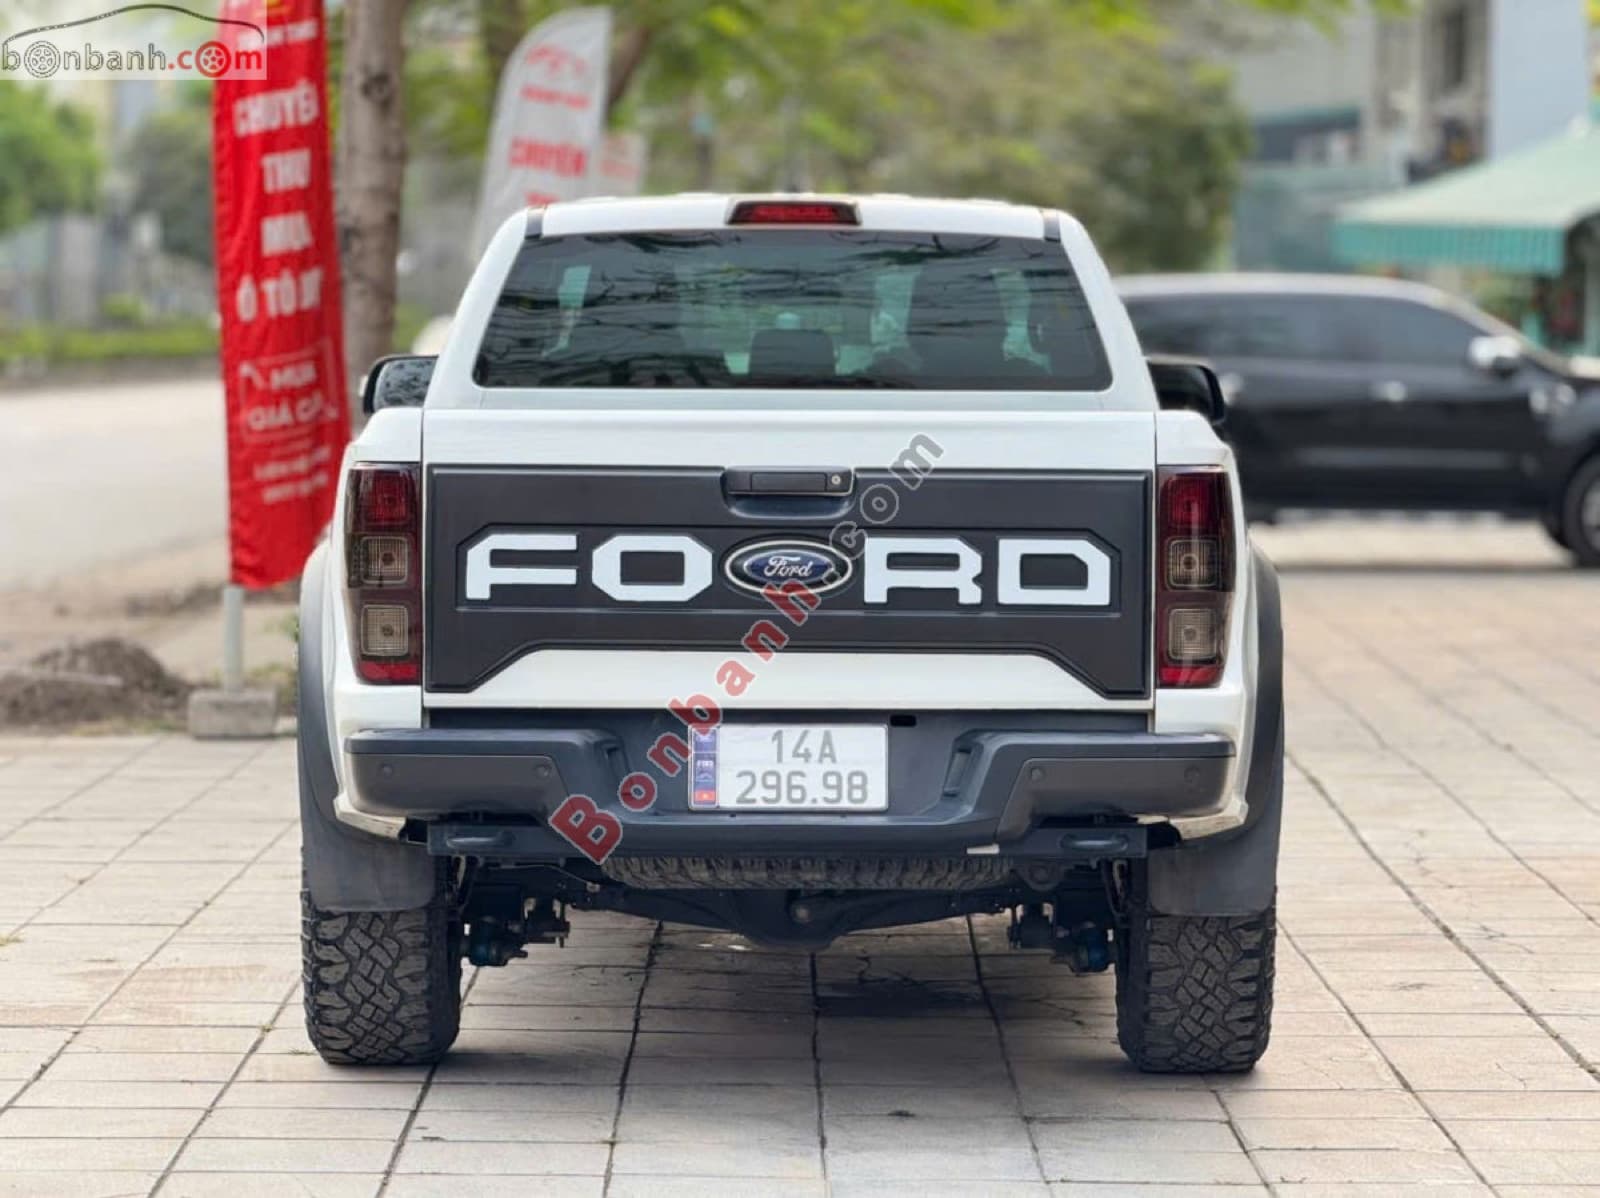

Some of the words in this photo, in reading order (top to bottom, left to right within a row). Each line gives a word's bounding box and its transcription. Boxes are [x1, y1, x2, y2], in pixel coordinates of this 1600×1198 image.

[764, 555, 814, 577] Ford
[771, 729, 838, 764] 14A
[735, 770, 869, 804] 296.98
